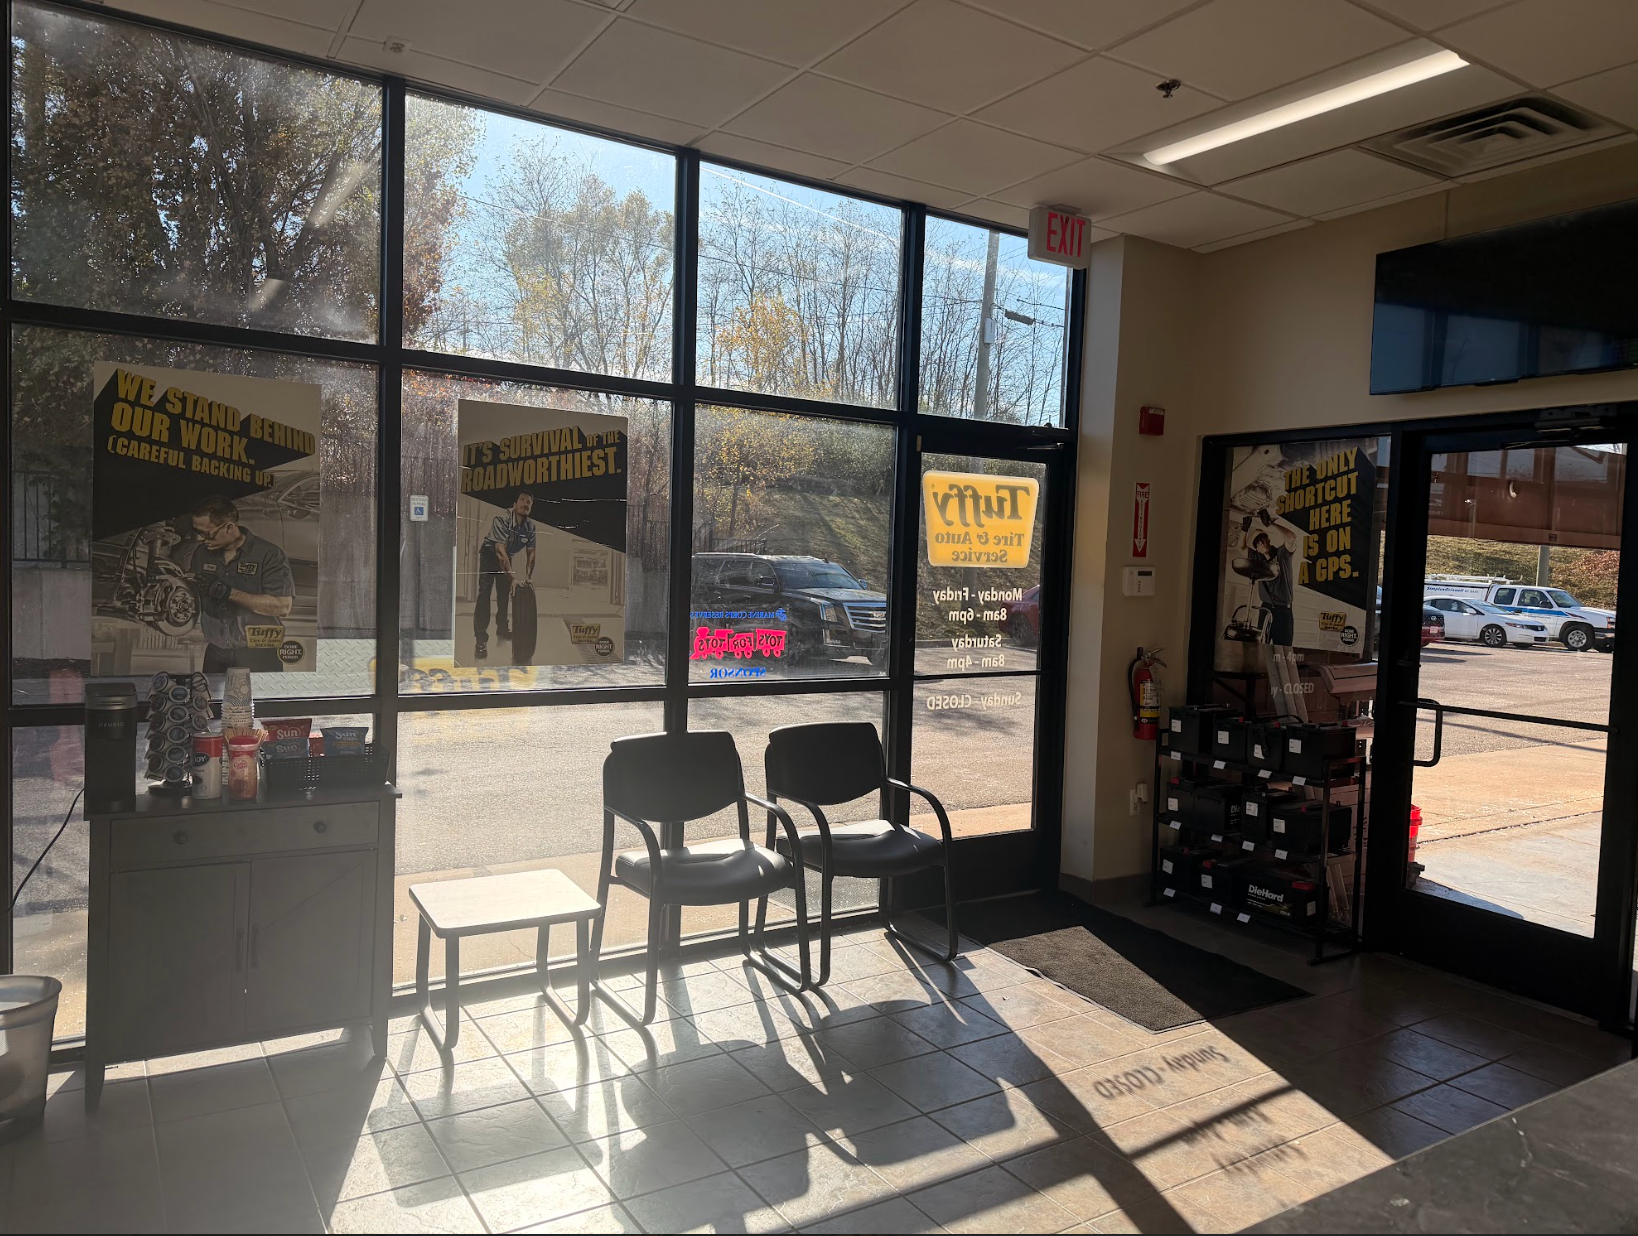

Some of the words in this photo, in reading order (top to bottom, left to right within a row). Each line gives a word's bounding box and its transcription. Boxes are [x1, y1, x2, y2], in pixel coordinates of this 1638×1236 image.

[1047, 212, 1086, 258] EXIT
[117, 368, 156, 407] WE
[166, 387, 241, 432] STAND
[250, 413, 315, 455] BEHIND
[111, 401, 170, 443] OUR
[180, 419, 255, 465] WORK.
[463, 442, 493, 466] IT'S
[499, 426, 582, 460] SURVIVAL
[586, 433, 600, 447] OF
[602, 430, 620, 445] THE
[107, 435, 186, 469] (CAREFUL
[191, 455, 251, 483] BACKING
[461, 446, 621, 493] ROADWORTHIEST.
[1284, 464, 1311, 492] THE
[1316, 446, 1358, 480] ONLY
[1276, 471, 1358, 515] SHORTCUT
[1309, 499, 1352, 531] HERE
[1303, 533, 1319, 558] IS
[1326, 526, 1351, 553] ON
[1298, 561, 1309, 584] A
[1316, 554, 1359, 582] GPS.
[248, 627, 282, 638] Tuffy
[573, 625, 597, 635] Tuffy
[1321, 613, 1343, 623] Tuffy
[1284, 682, 1314, 694] CLOSED
[276, 744, 298, 753] Sun
[277, 729, 298, 740] Sun
[335, 731, 356, 740] Sun
[1248, 884, 1284, 903] DieHard
